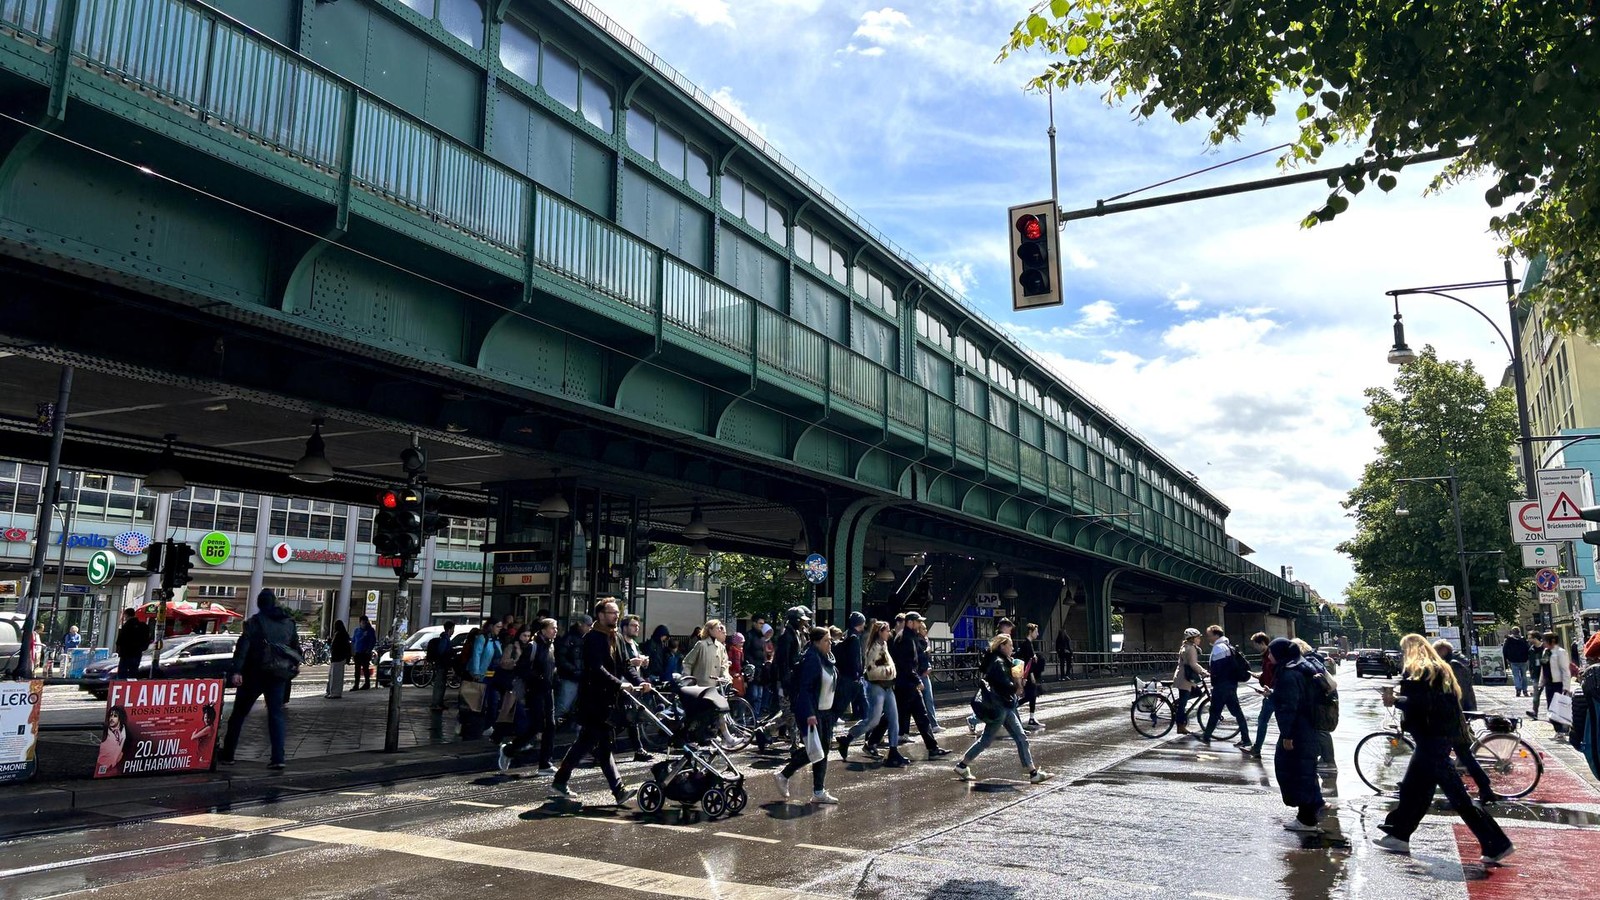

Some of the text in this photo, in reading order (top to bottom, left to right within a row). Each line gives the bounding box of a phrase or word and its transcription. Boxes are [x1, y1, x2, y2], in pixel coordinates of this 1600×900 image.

[293, 548, 347, 561] vodafone
[91, 554, 106, 580] S
[499, 564, 548, 573] Schönhauser Allee
[111, 682, 219, 707] FLAMENCO
[131, 705, 198, 716] ROSAS NEGRAS
[122, 755, 192, 774] PHILHARMONIE
